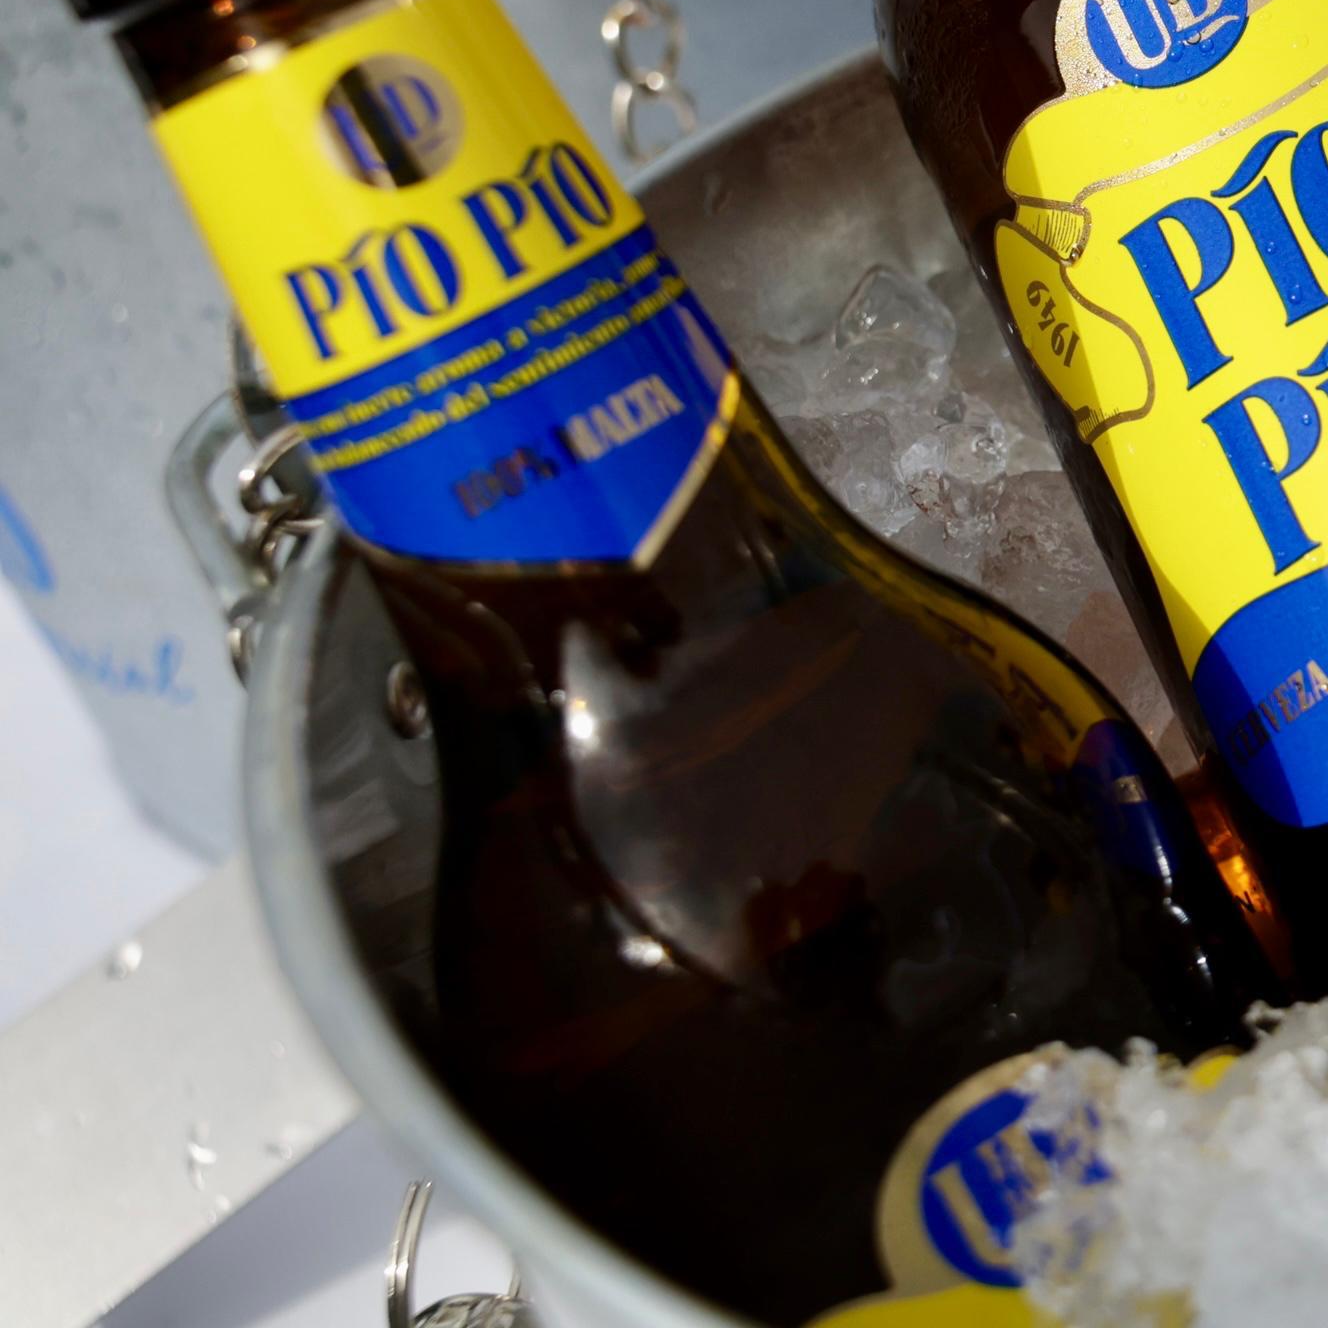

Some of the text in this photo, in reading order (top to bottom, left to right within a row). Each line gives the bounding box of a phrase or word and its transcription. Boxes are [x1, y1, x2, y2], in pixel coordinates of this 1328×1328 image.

[284, 140, 616, 361] PÍO PÍO
[507, 326, 528, 349] a
[1026, 280, 1080, 368] 1949
[555, 373, 684, 463] MALTA
